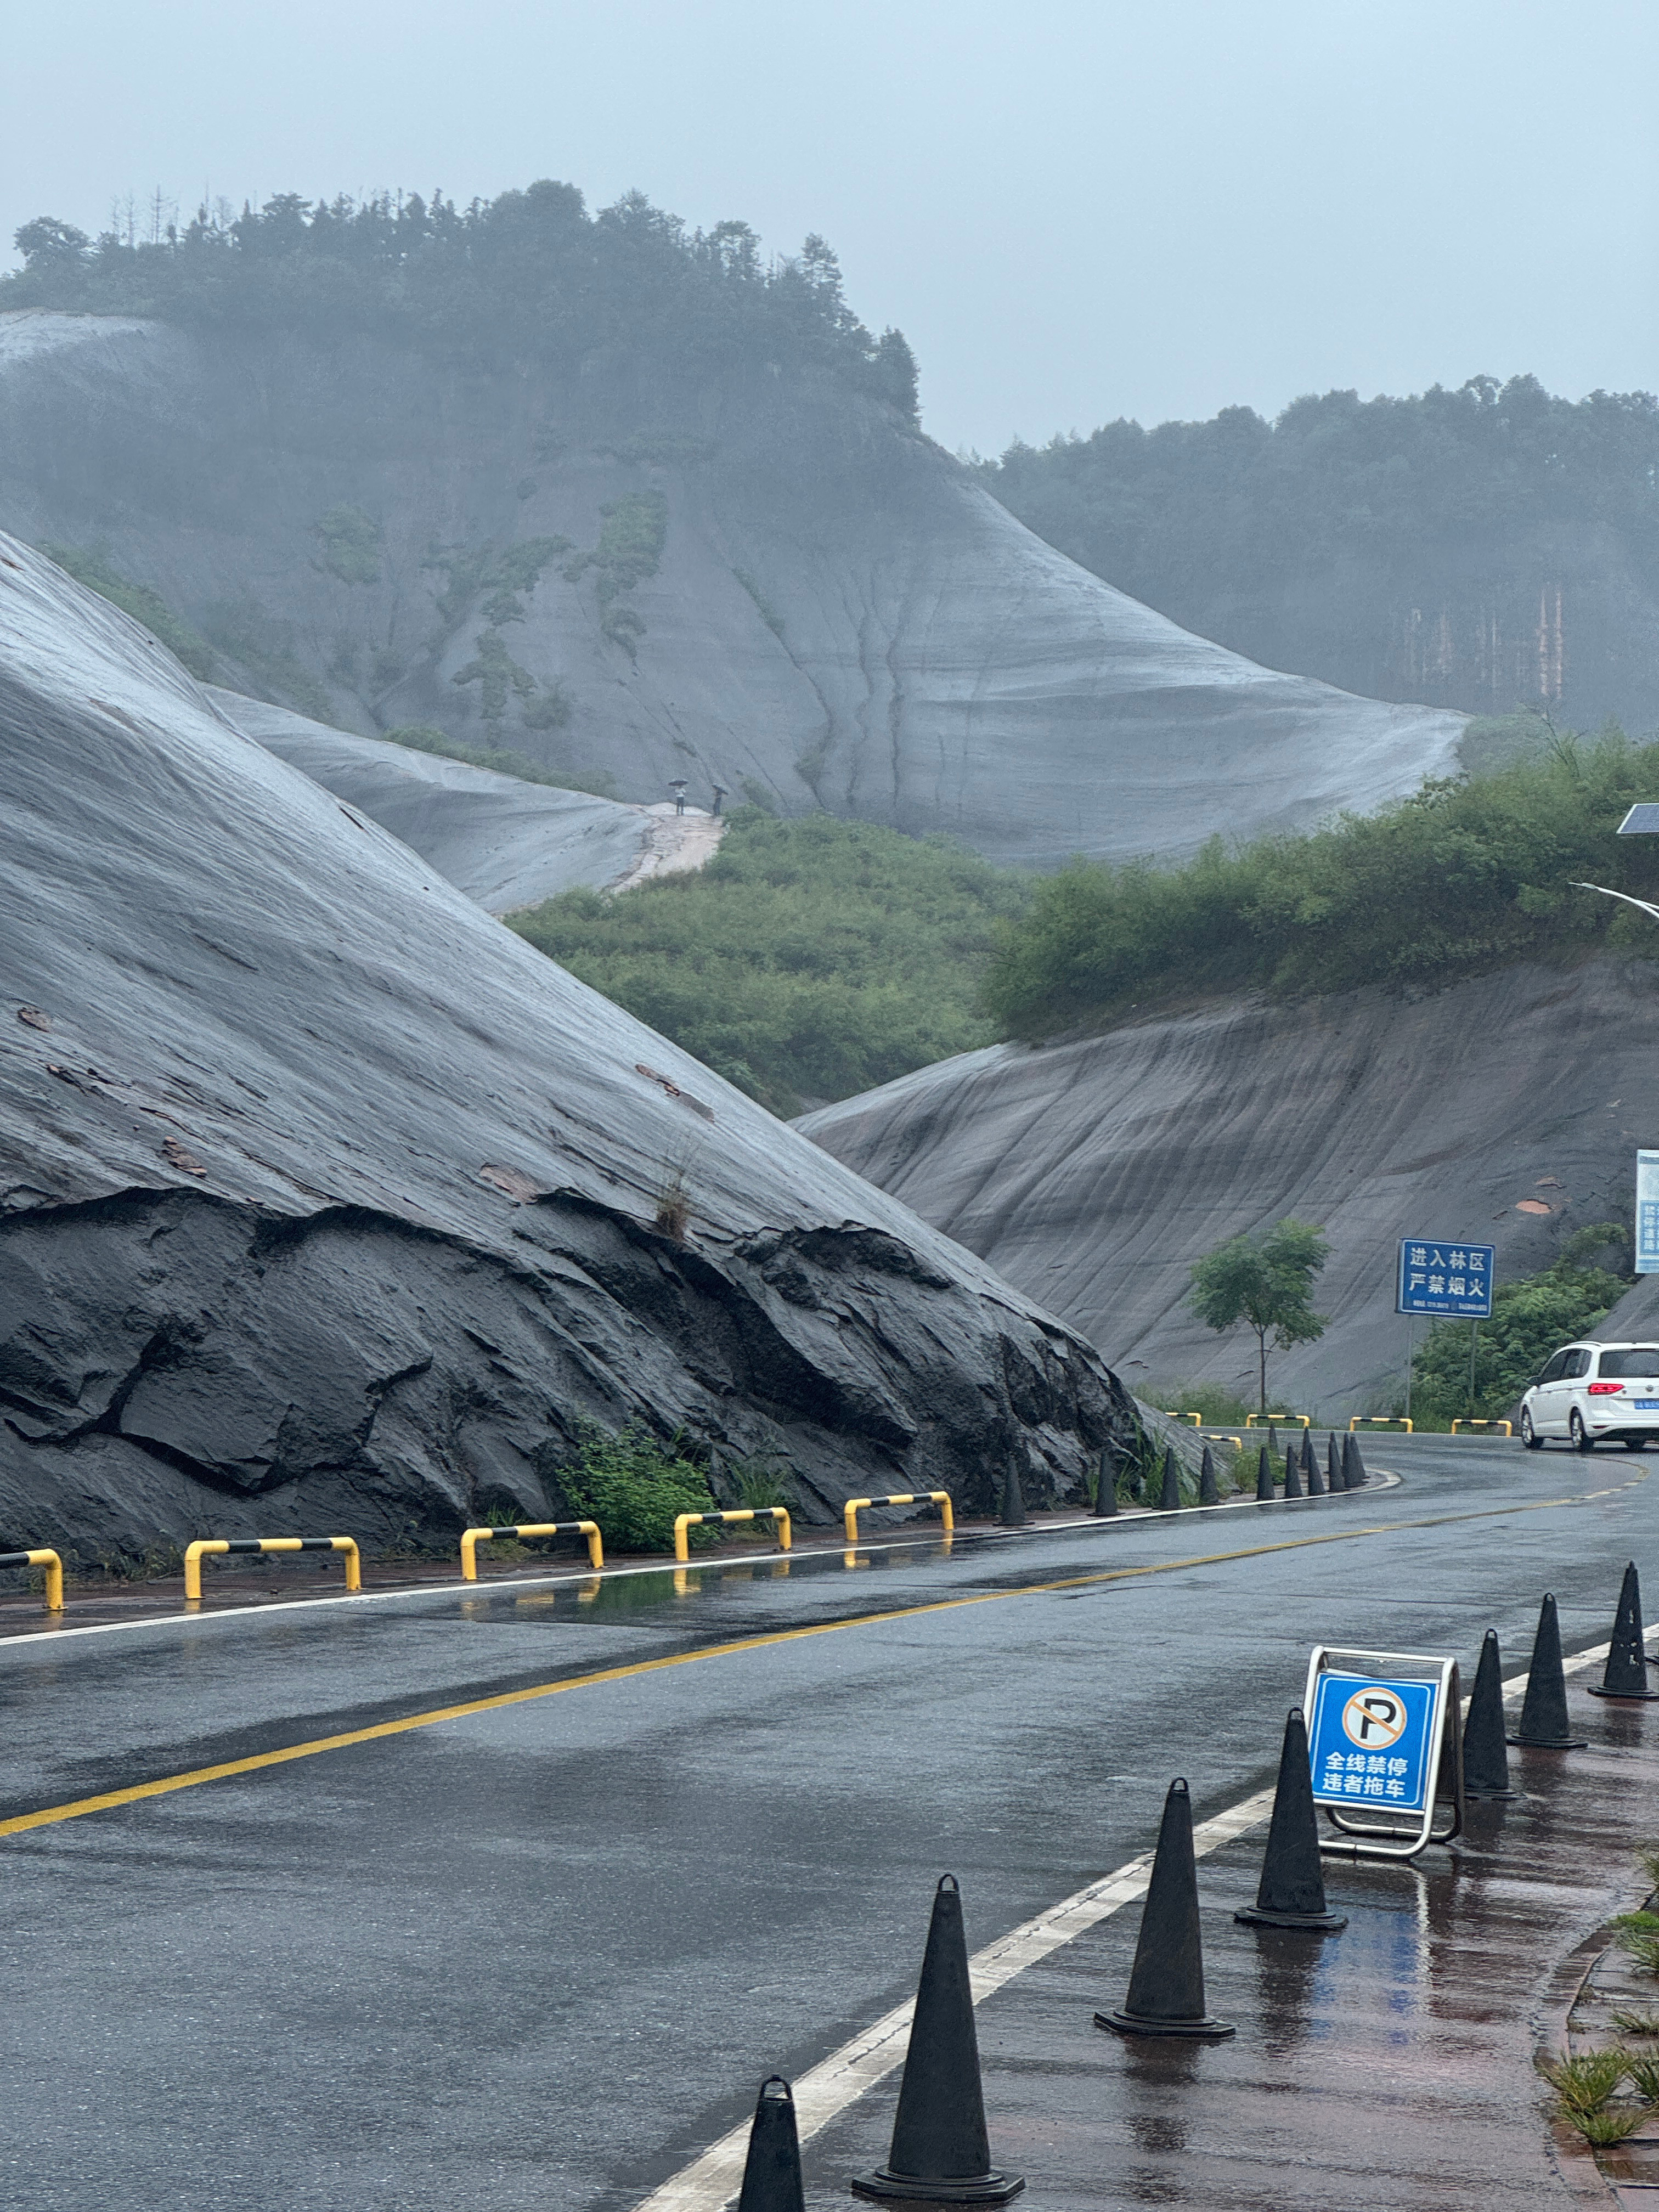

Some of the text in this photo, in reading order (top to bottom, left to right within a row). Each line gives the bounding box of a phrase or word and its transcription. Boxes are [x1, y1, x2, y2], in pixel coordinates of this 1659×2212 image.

[1410, 1247, 1486, 1271] 进入林区
[1409, 1273, 1485, 1297] 严禁烟火
[1325, 1751, 1408, 1777] 全线禁停
[1322, 1773, 1406, 1798] 违者拖车
